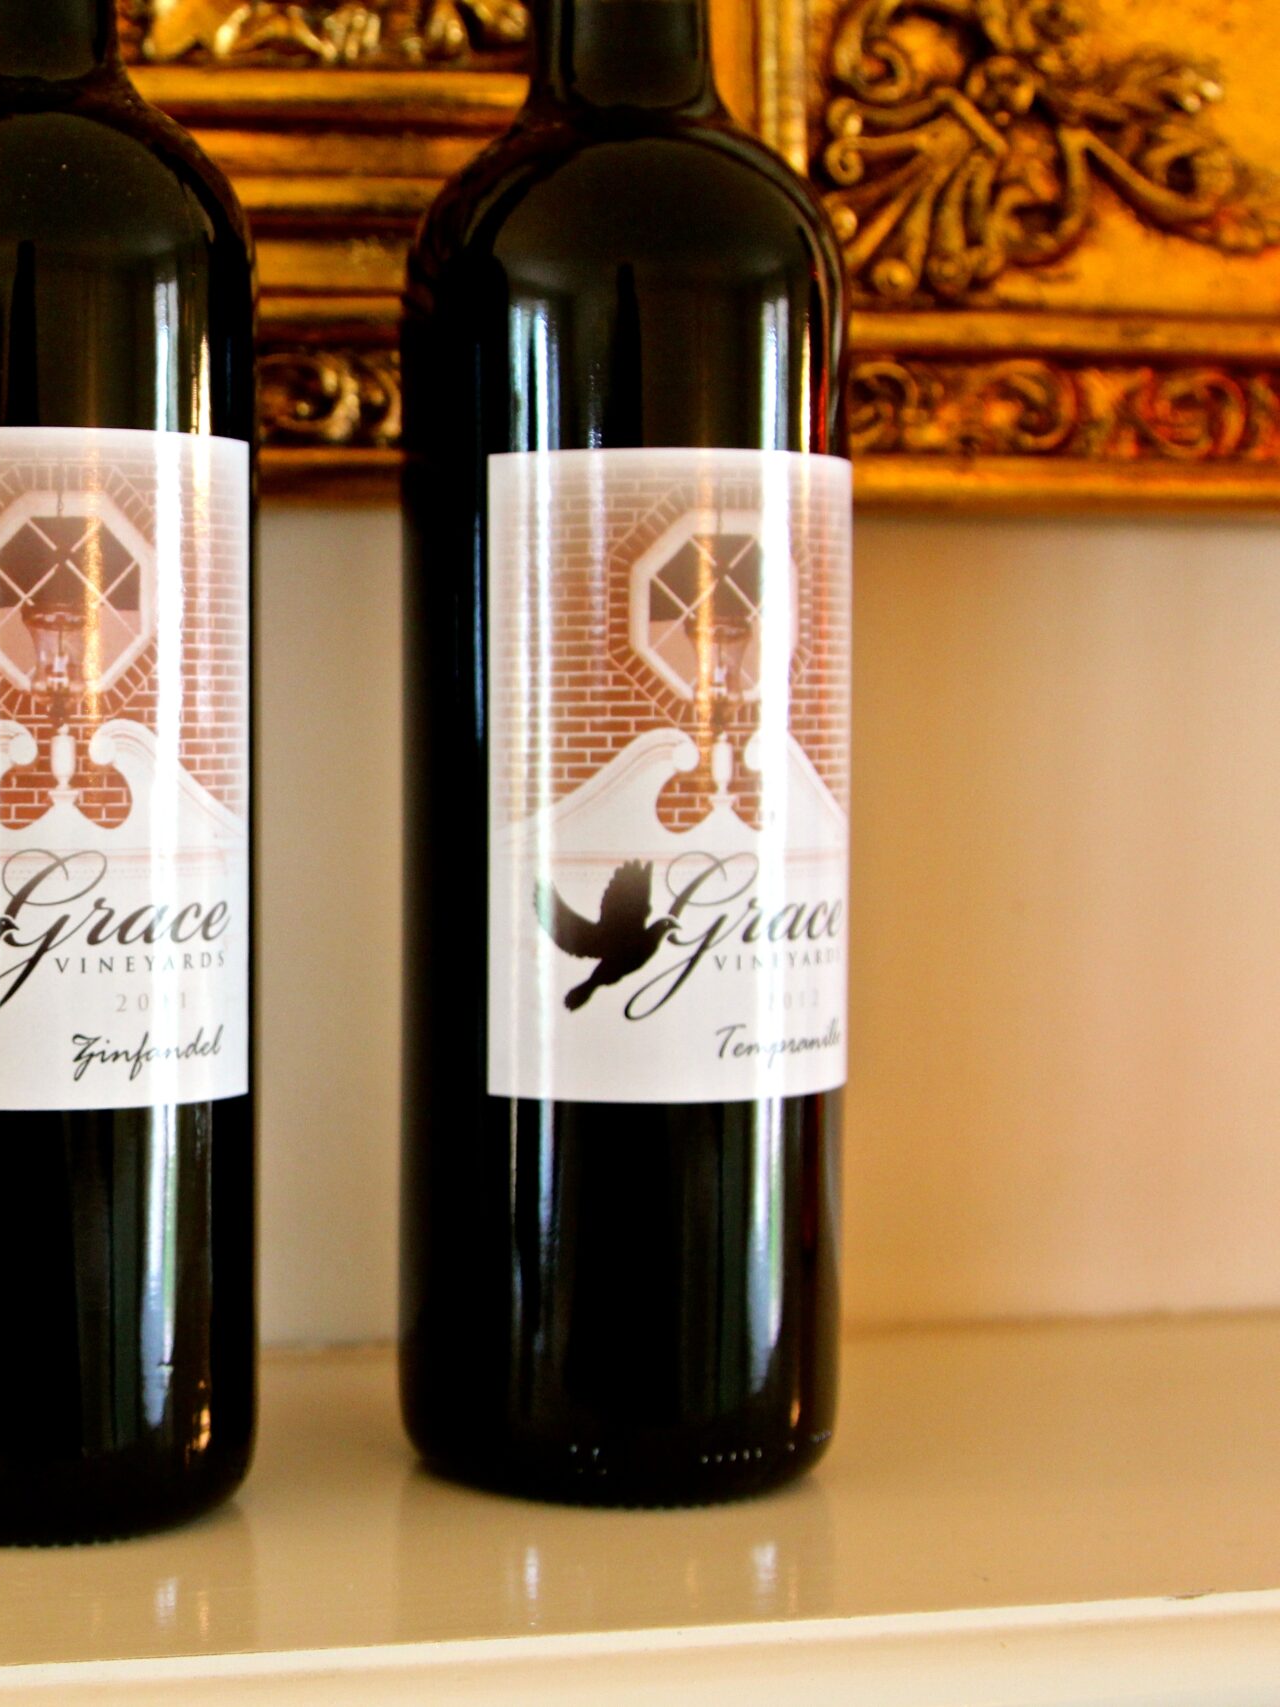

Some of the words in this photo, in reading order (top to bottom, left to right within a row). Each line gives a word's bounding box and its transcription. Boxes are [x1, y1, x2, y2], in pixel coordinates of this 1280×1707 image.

[54, 951, 225, 974] VINEYARDS
[623, 851, 842, 1021] Grace
[72, 1023, 224, 1082] Zinfandel
